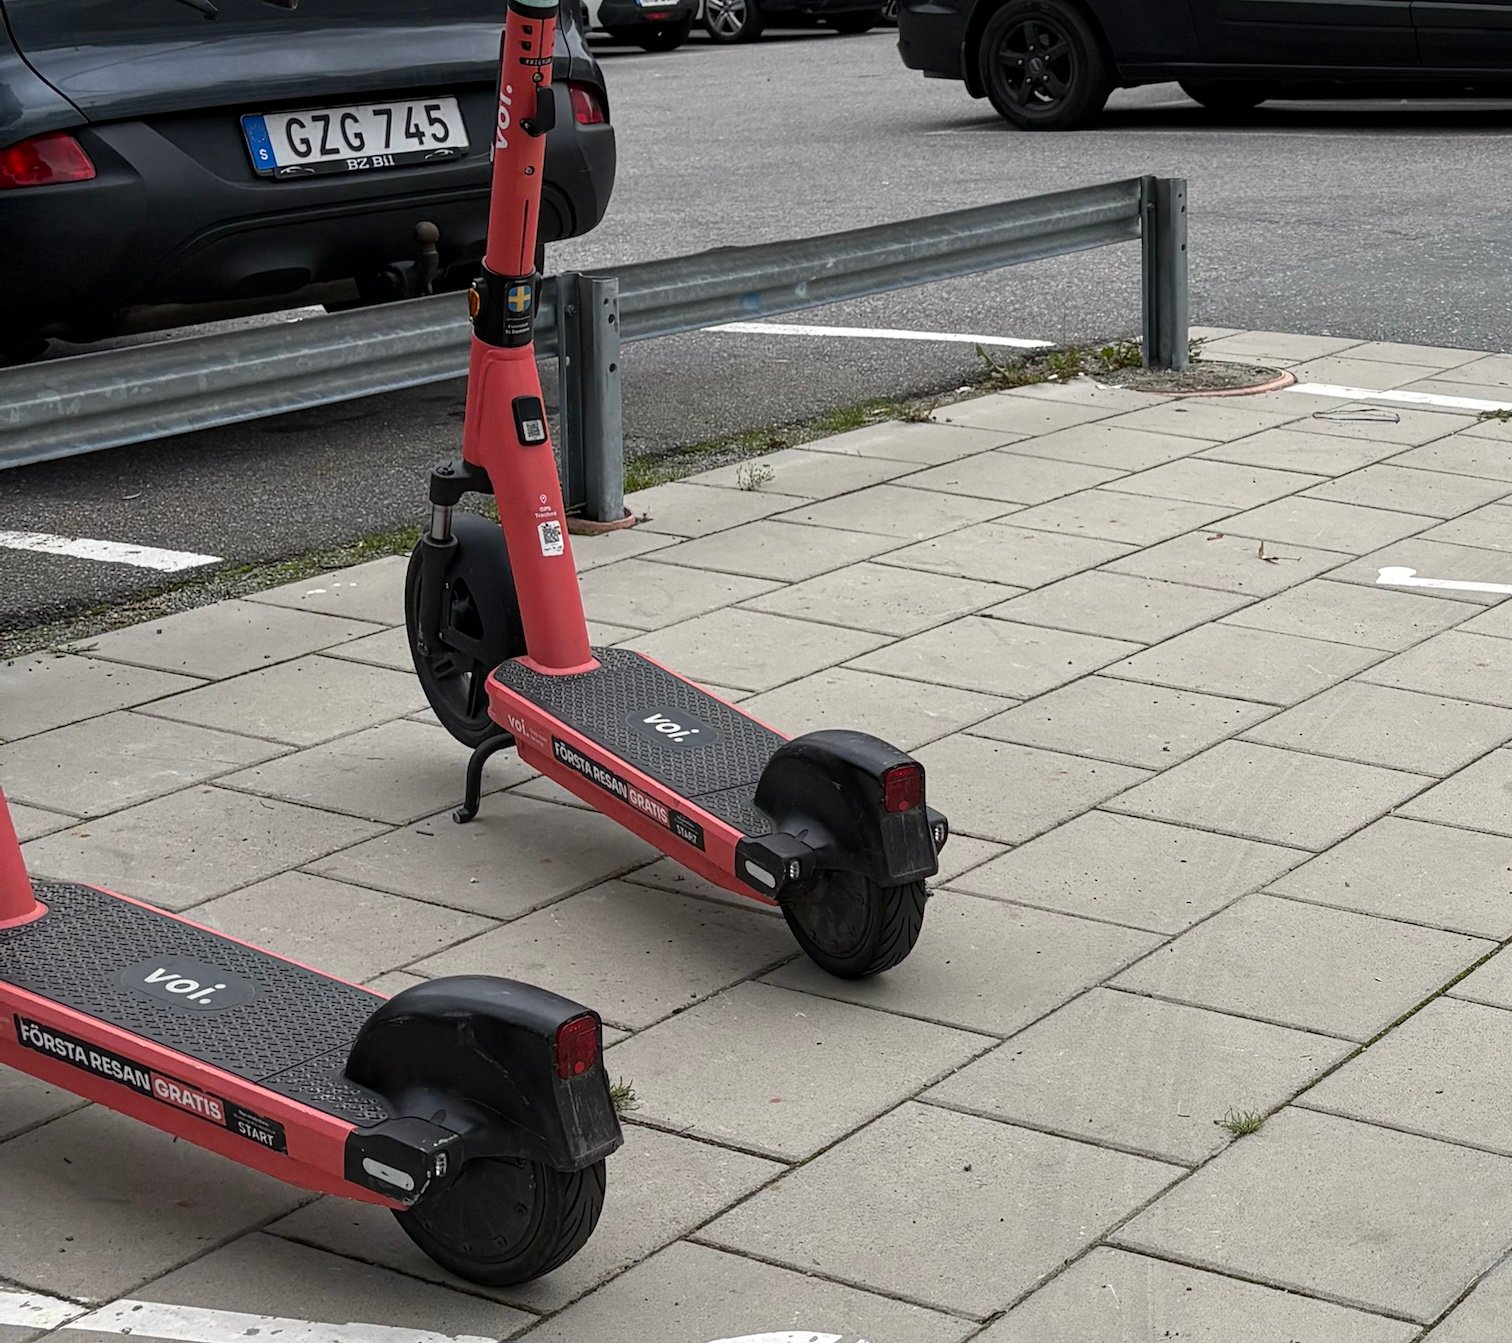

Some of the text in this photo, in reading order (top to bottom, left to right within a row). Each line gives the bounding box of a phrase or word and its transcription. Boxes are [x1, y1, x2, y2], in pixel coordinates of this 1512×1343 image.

[285, 103, 450, 158] GZG 745
[259, 148, 269, 160] S
[345, 157, 371, 171] BZ
[508, 714, 530, 739] voi.
[643, 713, 700, 743] voi.
[554, 741, 594, 779] FÖRSTA
[592, 765, 629, 799] RESAN
[628, 789, 670, 824] GRATIS
[676, 824, 699, 844] START
[143, 967, 227, 1005] voi.
[20, 1022, 223, 1121] FÖRSTA RESAN GRATIS
[237, 1120, 275, 1147] START
